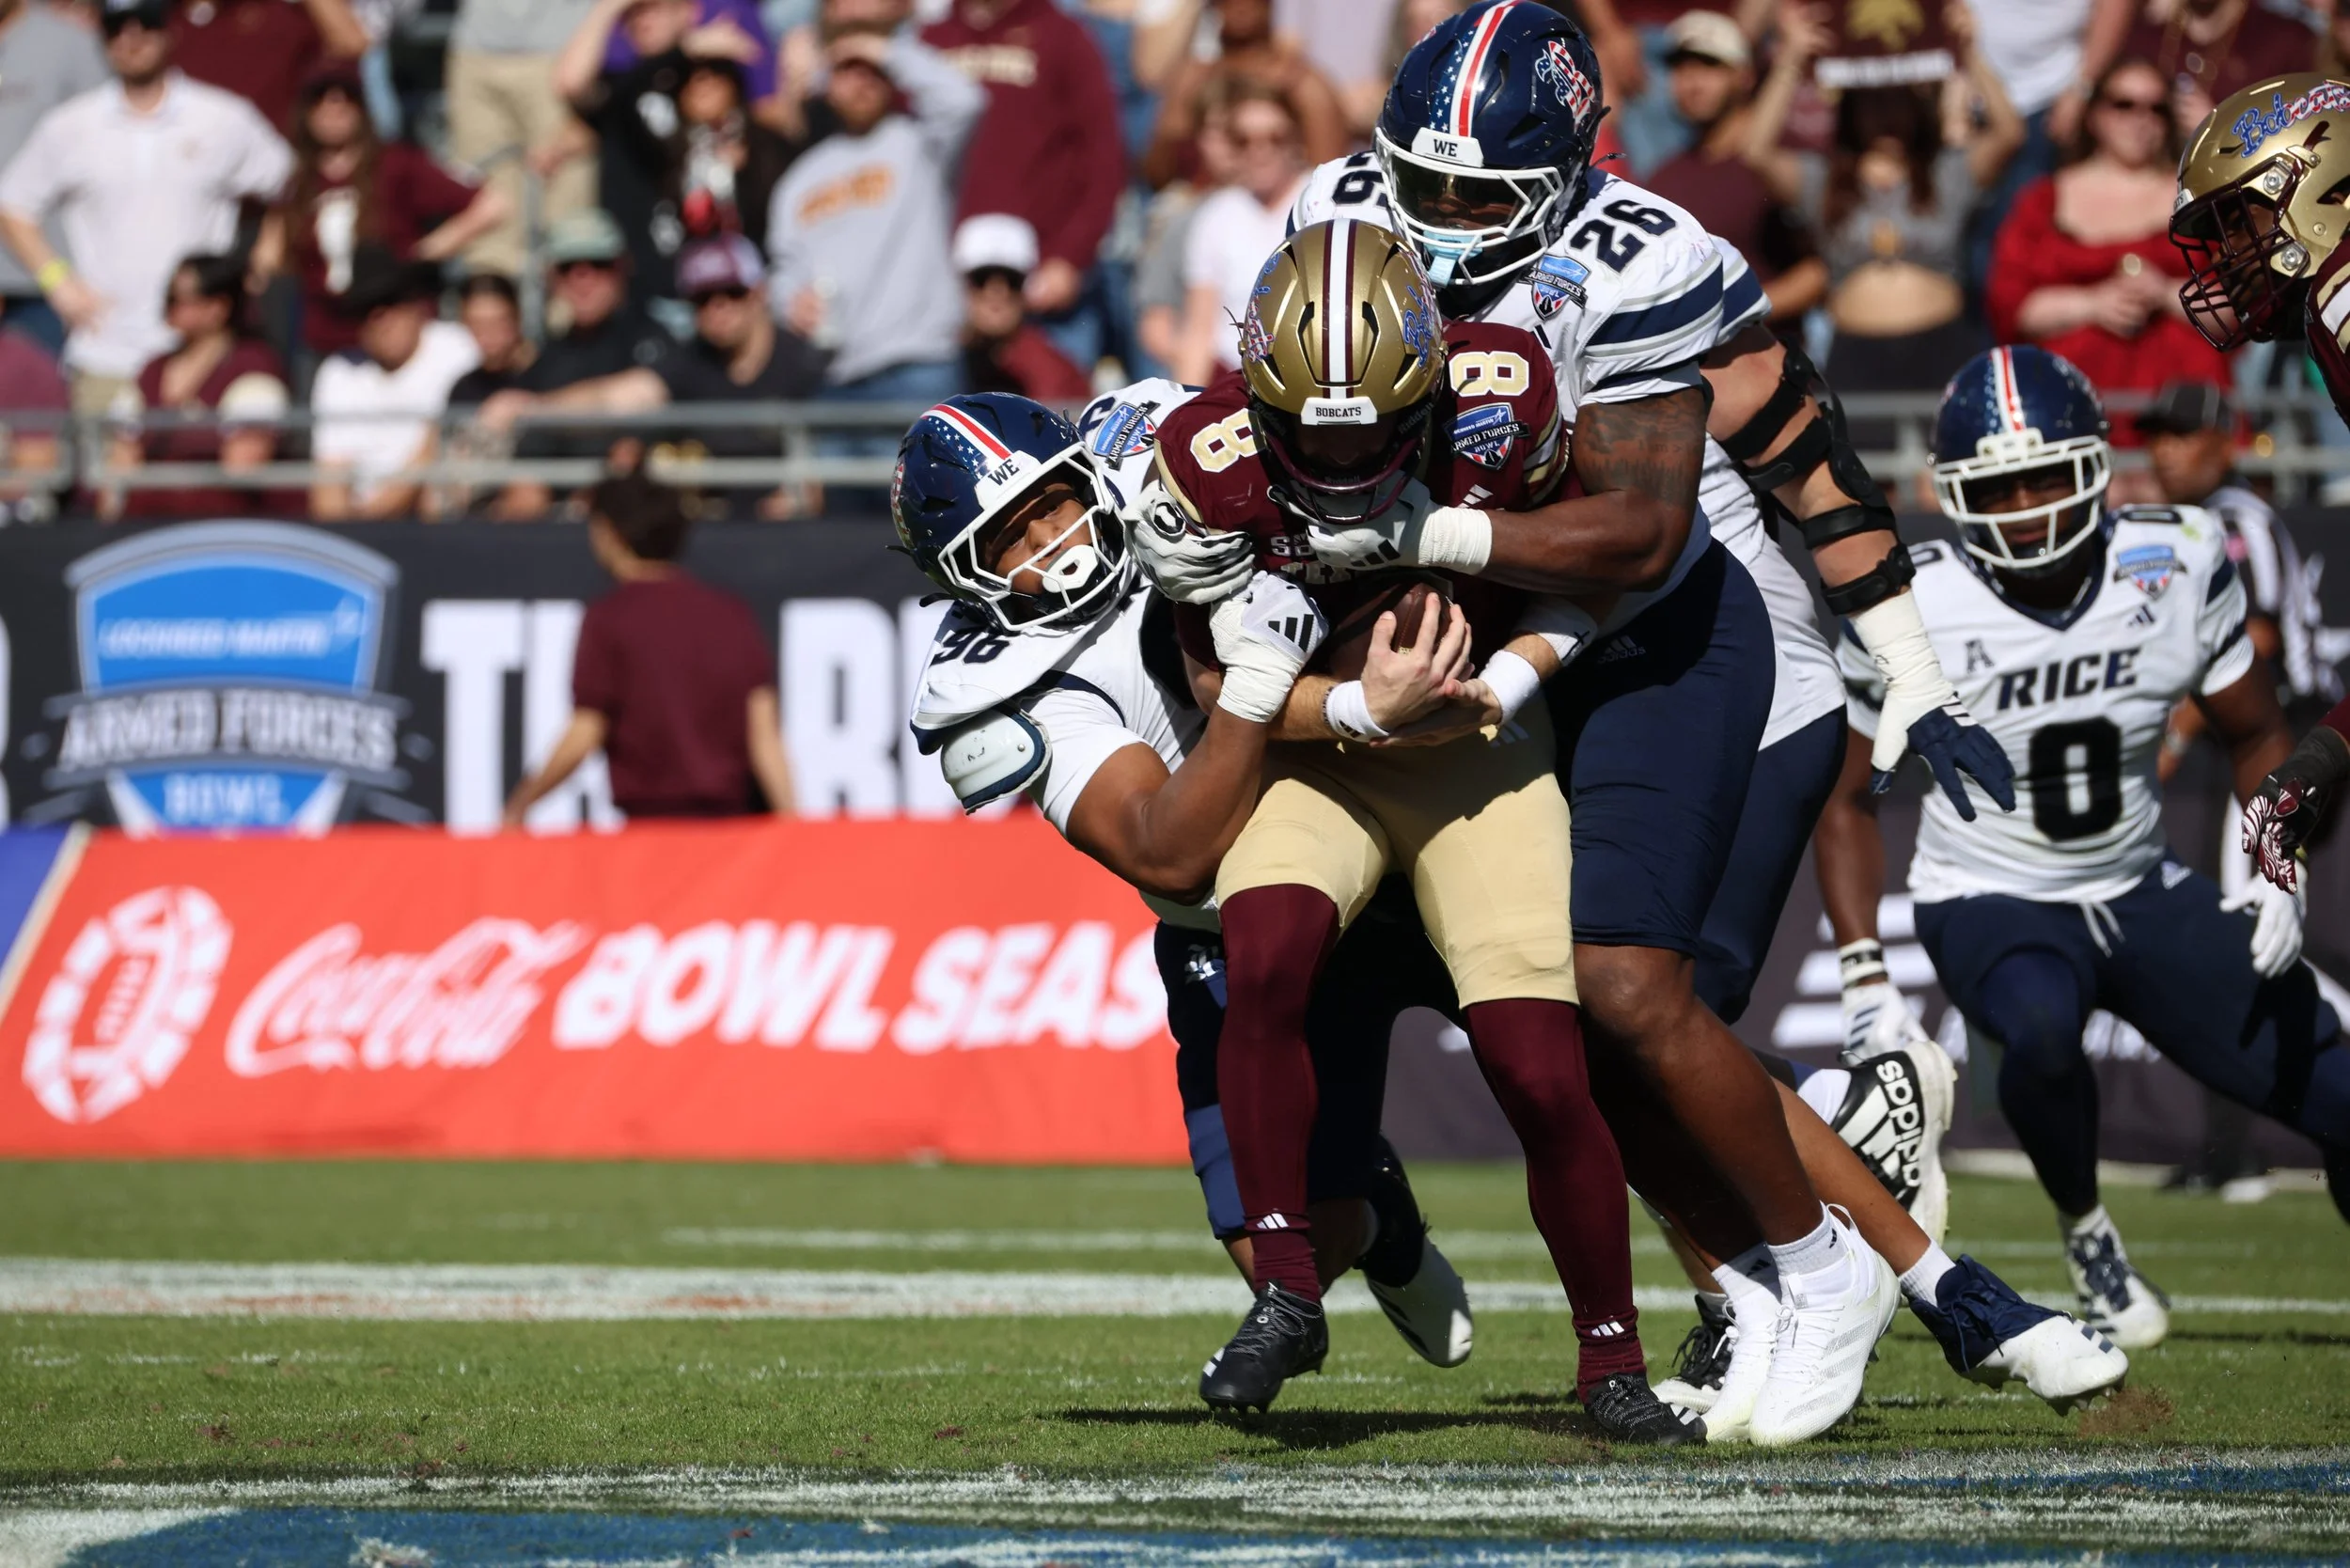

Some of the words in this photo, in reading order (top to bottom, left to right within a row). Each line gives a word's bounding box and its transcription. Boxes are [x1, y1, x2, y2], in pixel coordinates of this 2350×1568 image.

[1433, 138, 1458, 158] WE
[1569, 198, 1678, 274] 26
[1449, 351, 1530, 398] 8
[1108, 432, 1128, 463] ARMED
[1121, 404, 1149, 434] FORCES
[1126, 424, 1145, 447] BOWL
[1315, 406, 1362, 418] BOBCATS
[1480, 422, 1521, 440] FORCES
[1189, 407, 1261, 474] 8
[1474, 439, 1500, 453] BOWL
[987, 459, 1020, 486] WE
[929, 627, 1011, 666] 96
[1997, 646, 2142, 712] RICE
[58, 690, 219, 771] ARMED
[222, 688, 397, 771] FORCES
[2028, 714, 2123, 842] 0
[553, 919, 895, 1053] BOWL
[1876, 1059, 1922, 1188] adidas
